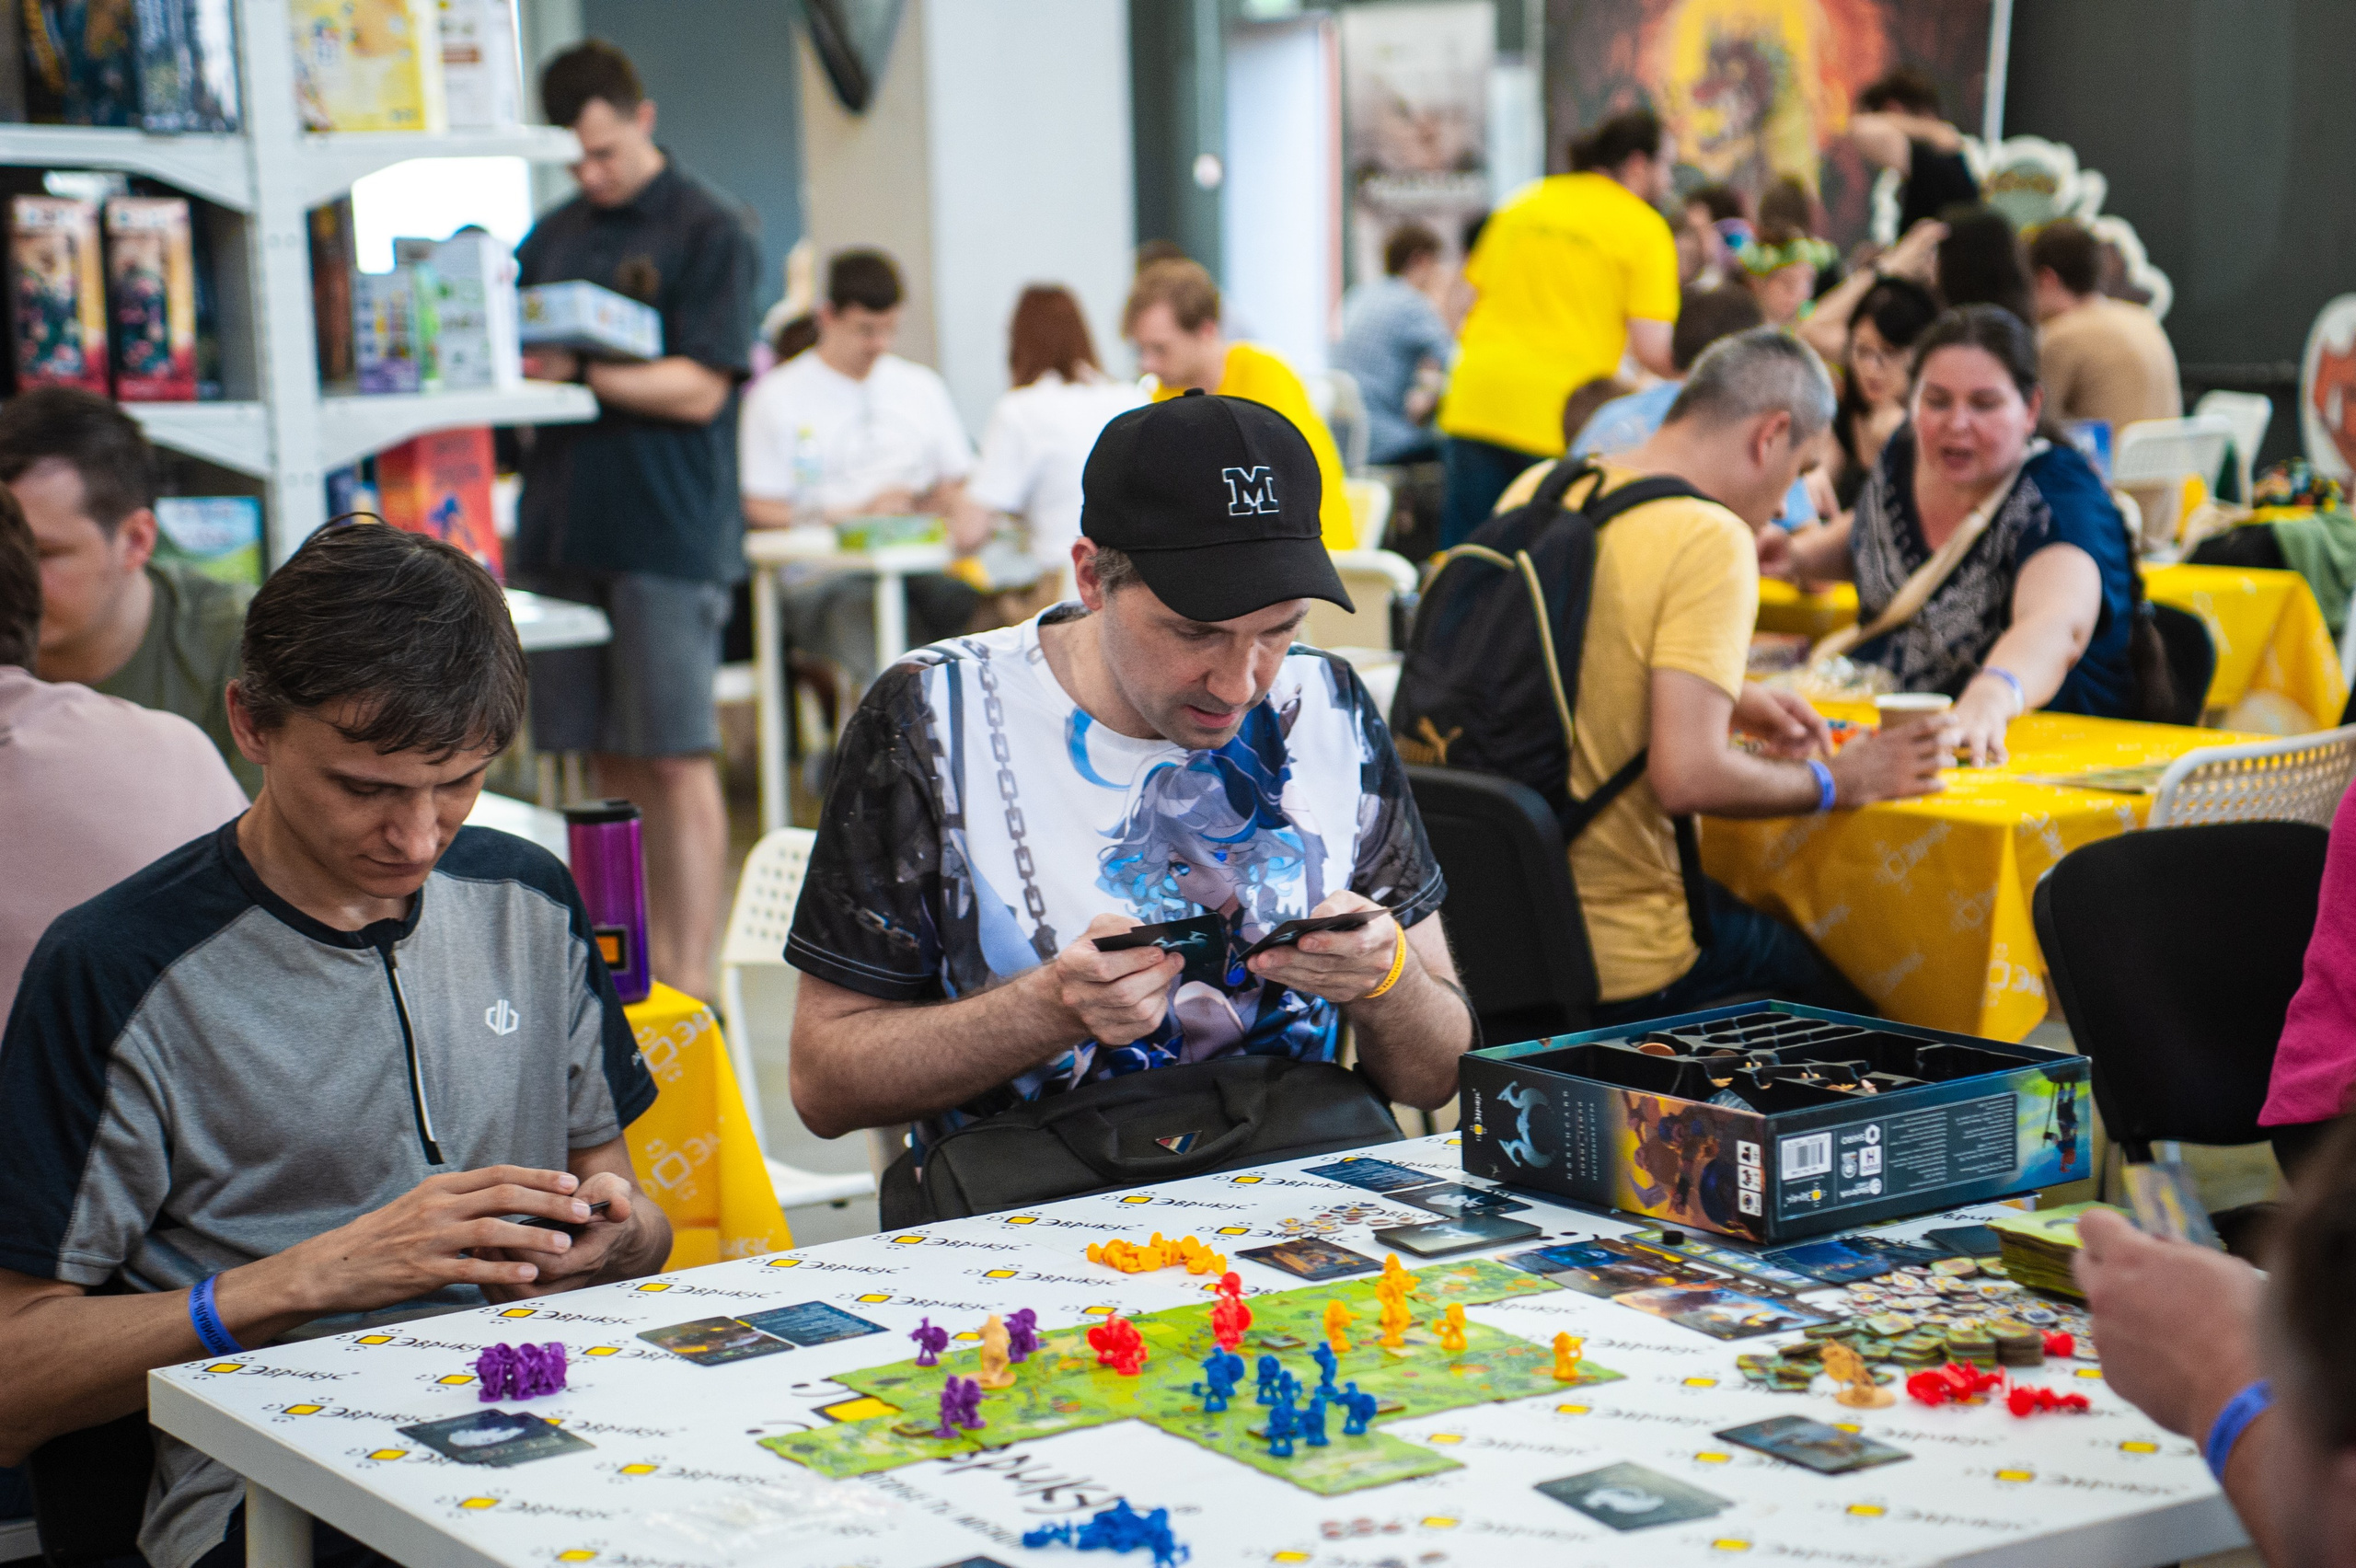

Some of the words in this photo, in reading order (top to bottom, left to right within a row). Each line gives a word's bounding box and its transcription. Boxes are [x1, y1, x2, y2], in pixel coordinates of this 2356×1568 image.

[1222, 466, 1279, 515] M
[1563, 1090, 1573, 1181] NORTHGARD
[1262, 1179, 1357, 1191] Эврикус
[1152, 1198, 1249, 1211] Эврикус
[1037, 1219, 1135, 1231] Эврикус
[925, 1238, 1022, 1251] Эврикус
[799, 1261, 897, 1274] Эврикус
[1016, 1272, 1121, 1286] Эврикус
[669, 1286, 769, 1300] Эврикус
[891, 1296, 993, 1311] Эврикус
[537, 1311, 637, 1325] Эврикус
[1591, 1339, 1705, 1355] Эврикус
[238, 1366, 346, 1381] Эврикус
[325, 1407, 430, 1424] Эврикус
[570, 1421, 675, 1439] Эврикус
